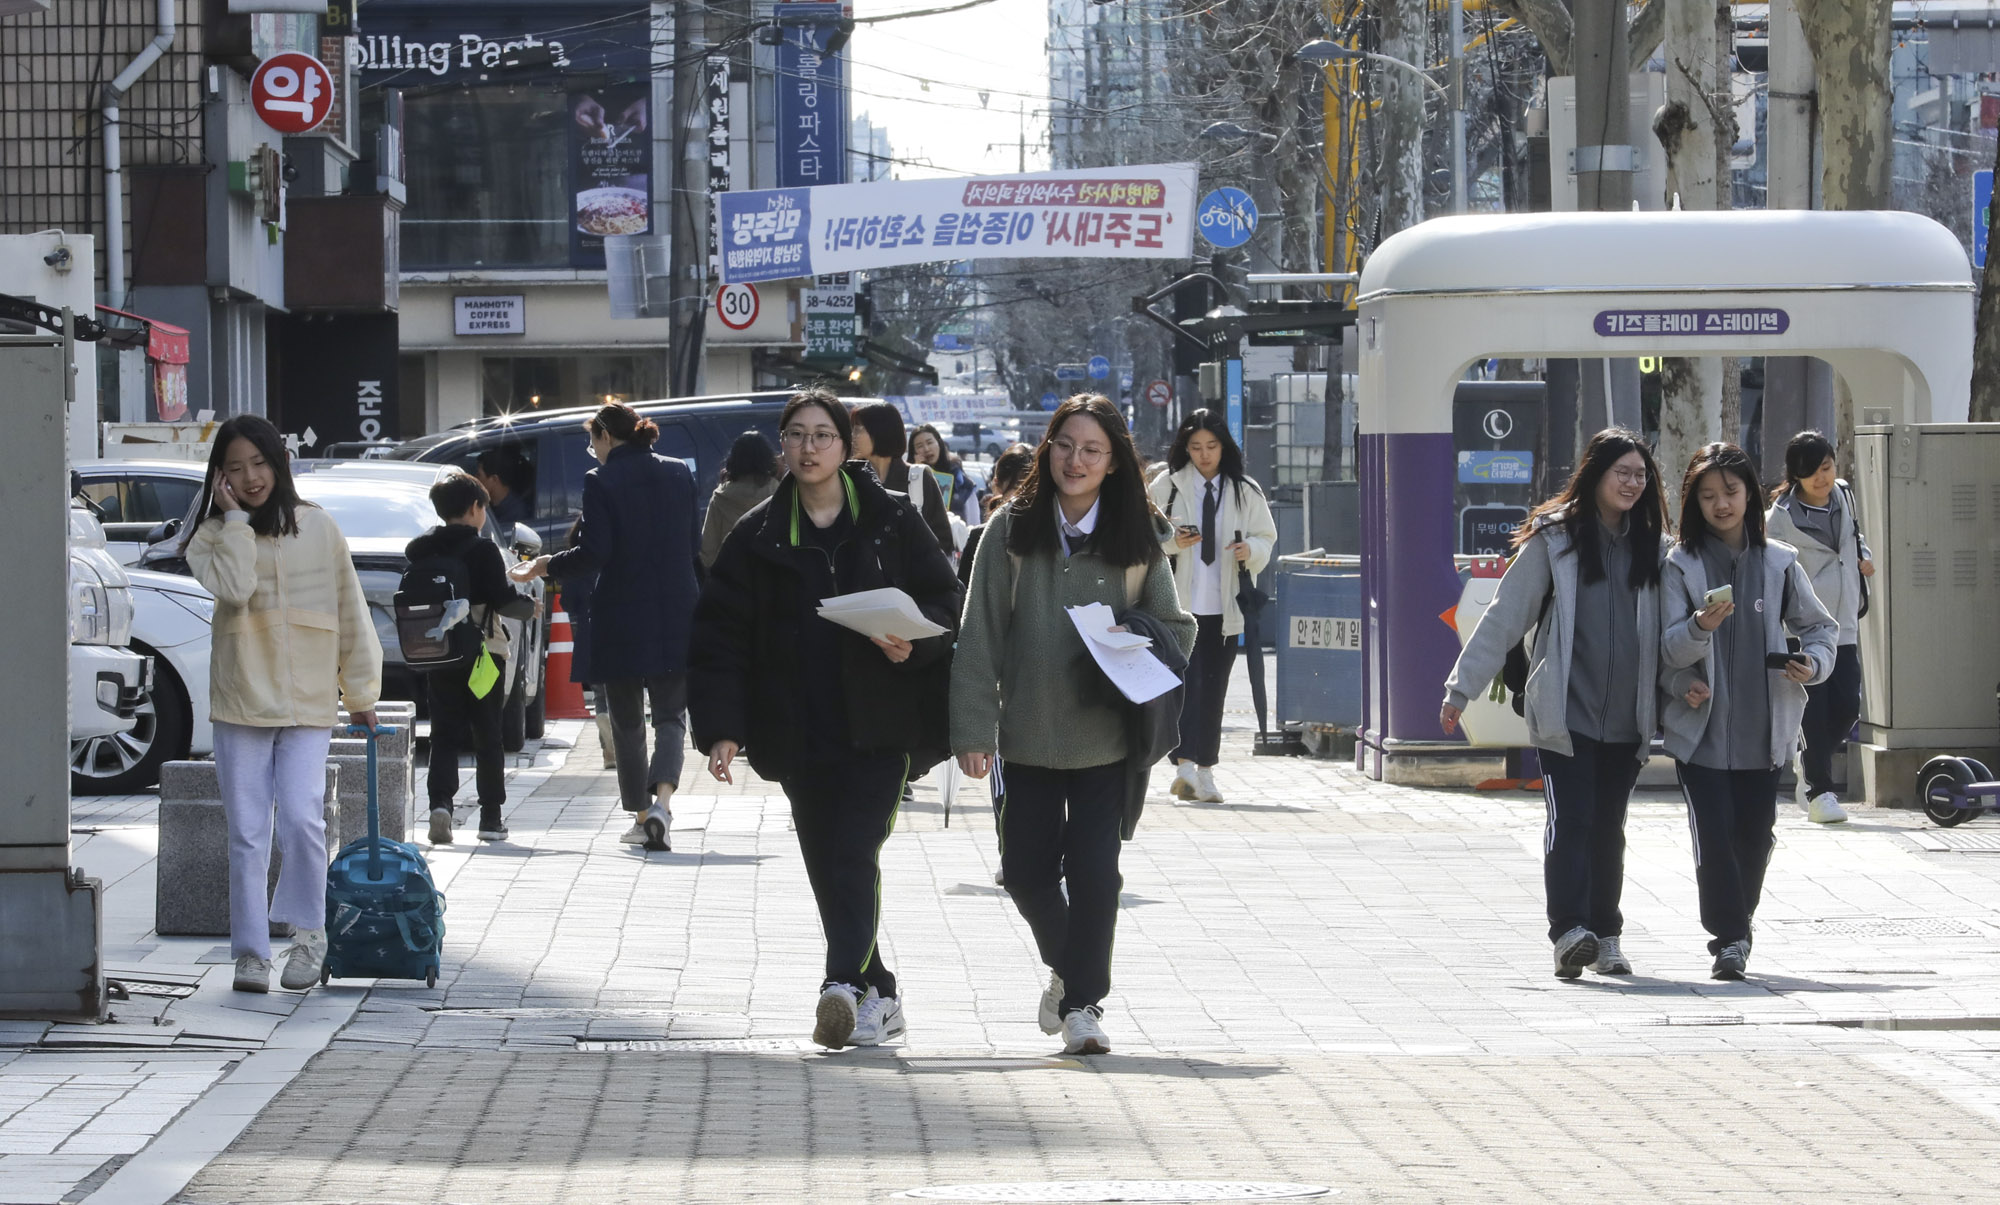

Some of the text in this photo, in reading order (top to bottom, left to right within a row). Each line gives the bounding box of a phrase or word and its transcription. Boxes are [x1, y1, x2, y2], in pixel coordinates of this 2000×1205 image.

[326, 5, 348, 26] B1
[262, 66, 322, 124] 약
[797, 54, 823, 181] 롤링파스타
[465, 300, 514, 309] MAMMOTH
[725, 292, 750, 315] 30
[469, 320, 511, 329] EXPRESS
[470, 310, 508, 319] COFFEE
[1606, 312, 1778, 333] 키즈플레이 스테이션
[829, 318, 854, 335] 환영
